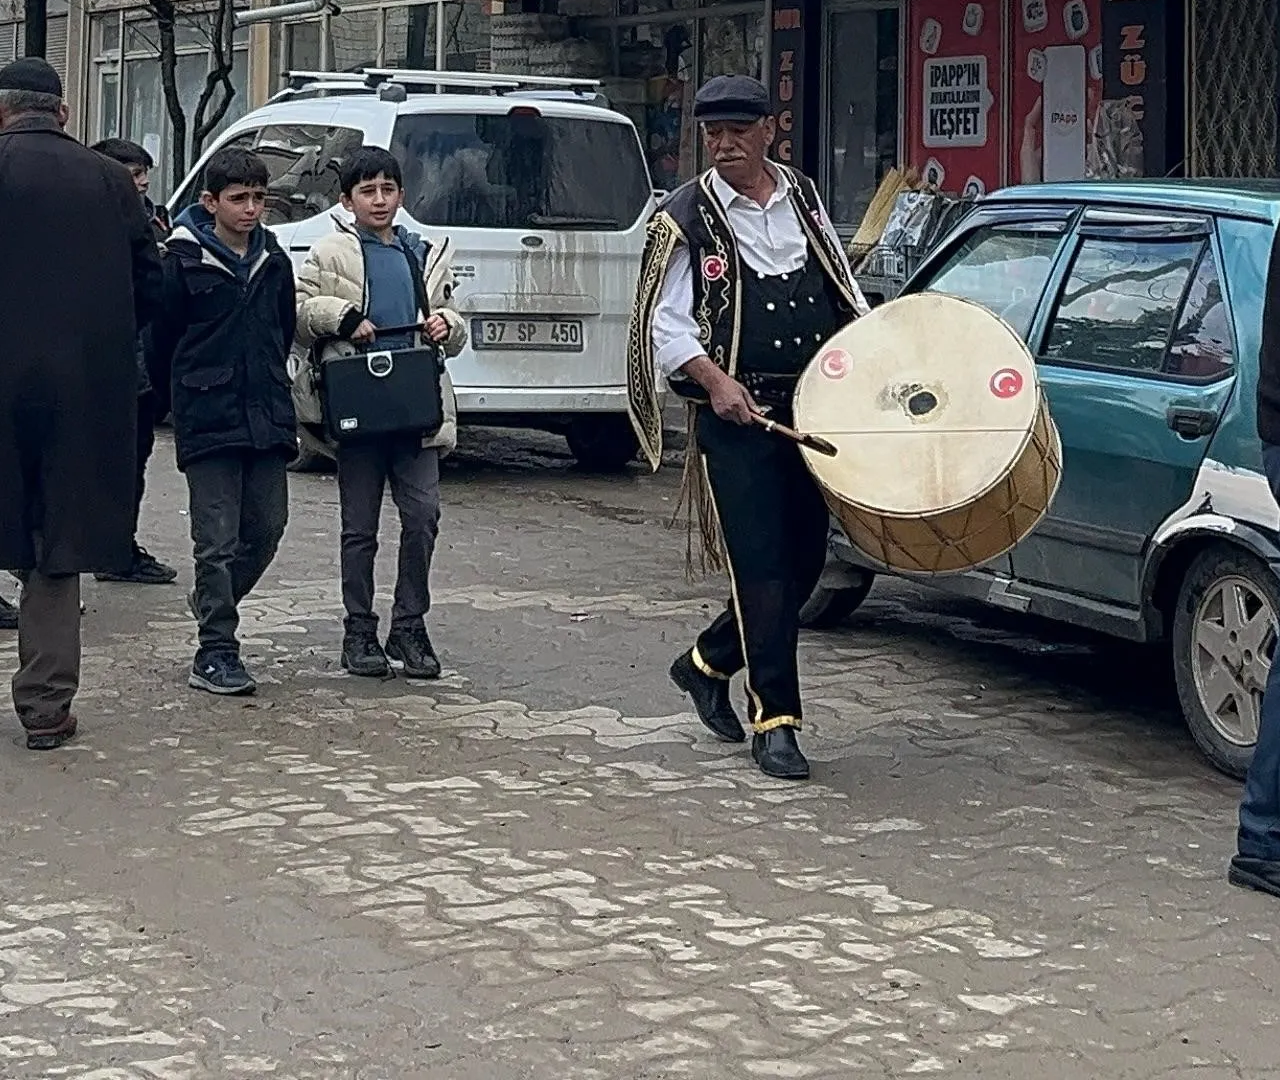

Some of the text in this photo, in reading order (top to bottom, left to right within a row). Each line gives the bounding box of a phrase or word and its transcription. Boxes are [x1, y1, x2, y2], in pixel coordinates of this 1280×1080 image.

[930, 107, 980, 139] KEŞFET
[487, 323, 506, 341] 37
[518, 323, 536, 342] SP
[551, 324, 578, 342] 450
